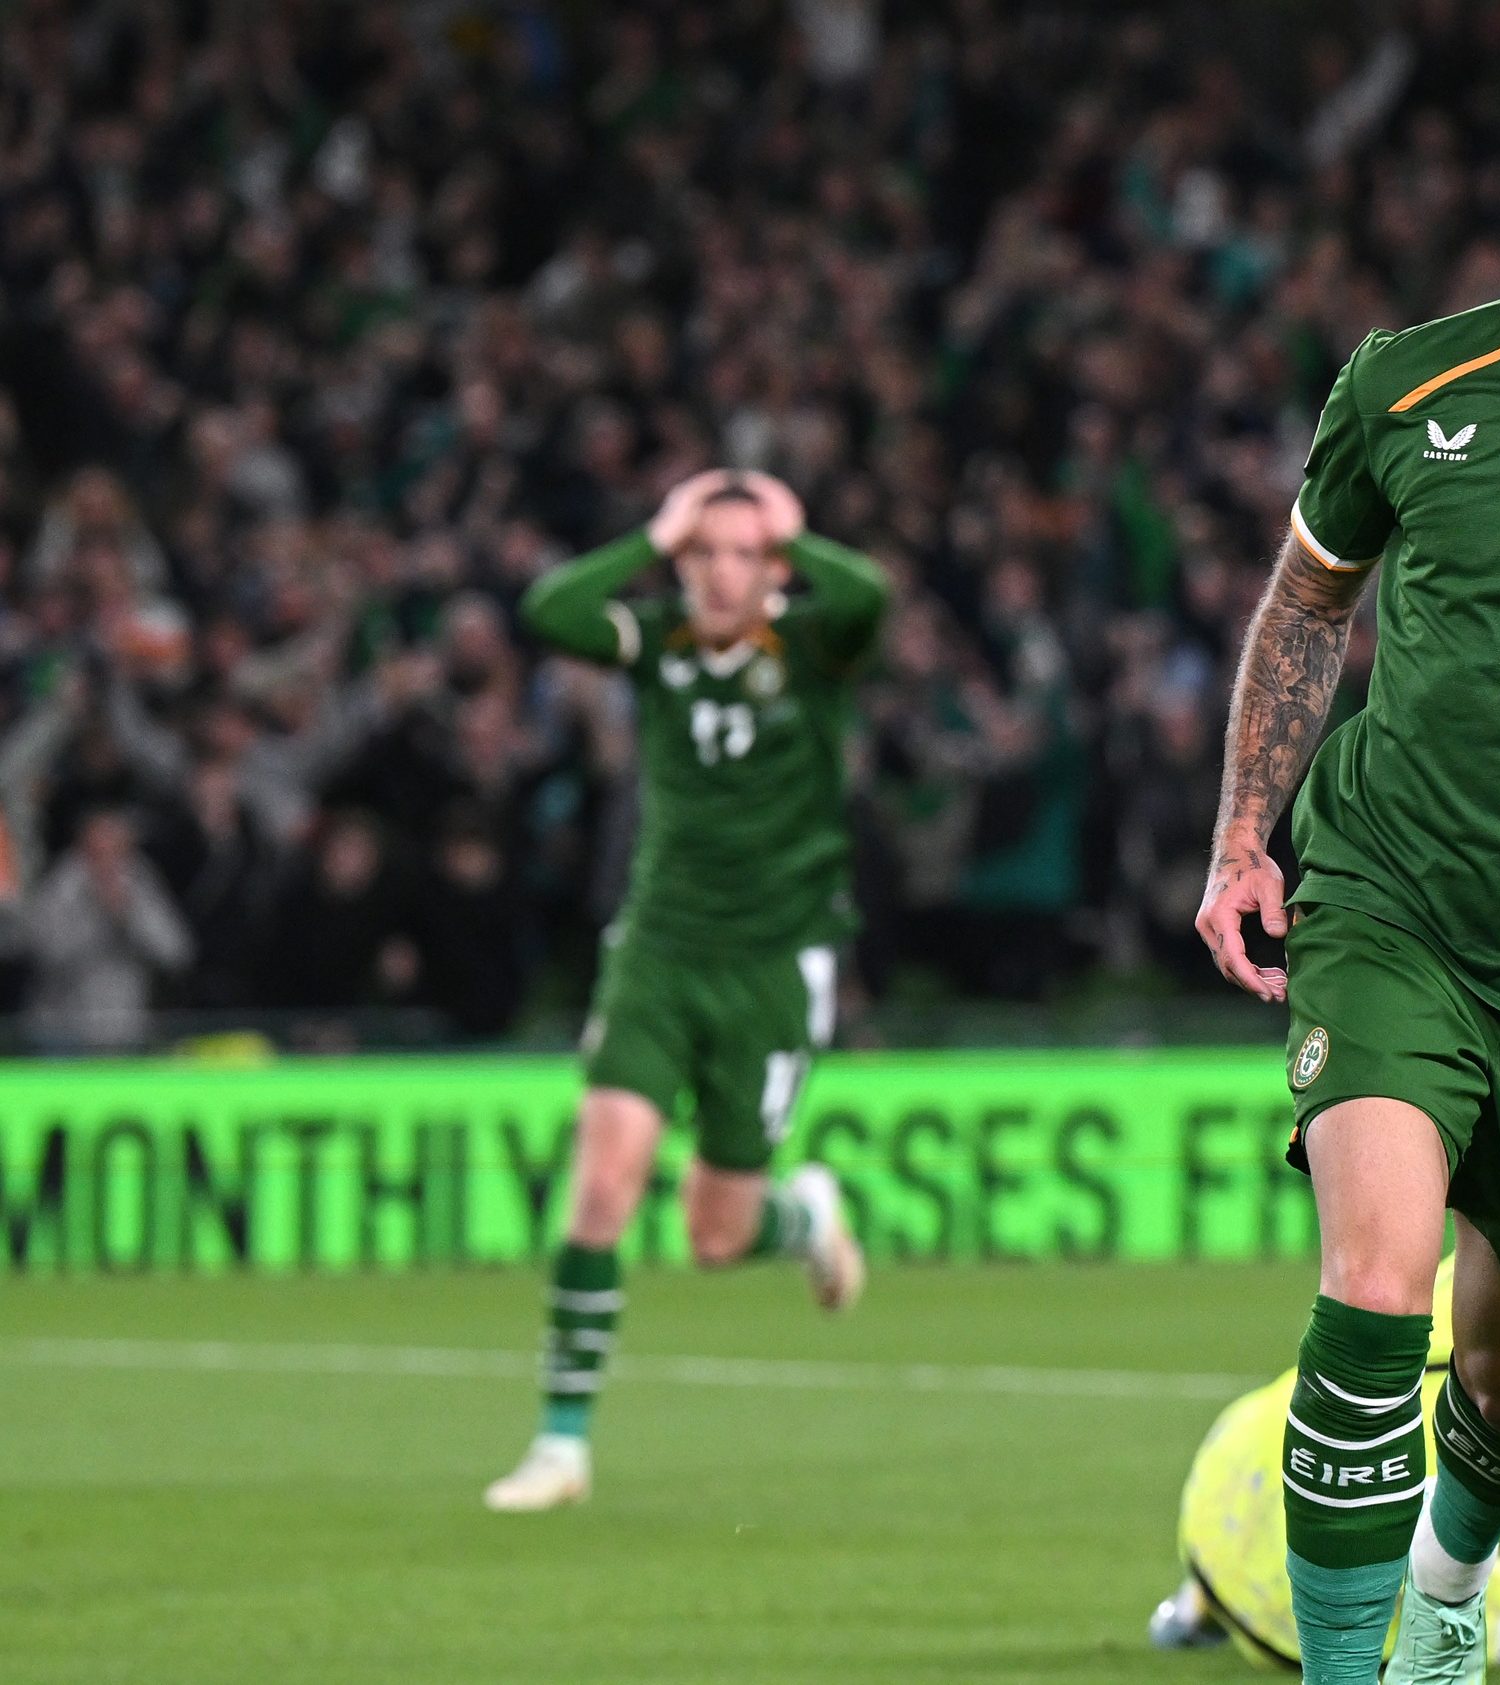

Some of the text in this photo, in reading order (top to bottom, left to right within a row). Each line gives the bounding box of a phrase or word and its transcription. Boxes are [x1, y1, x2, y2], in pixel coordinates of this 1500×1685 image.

[0, 1114, 582, 1270] MONTHLY
[1181, 1103, 1323, 1263] FR
[1290, 1447, 1411, 1487] ÉIRE
